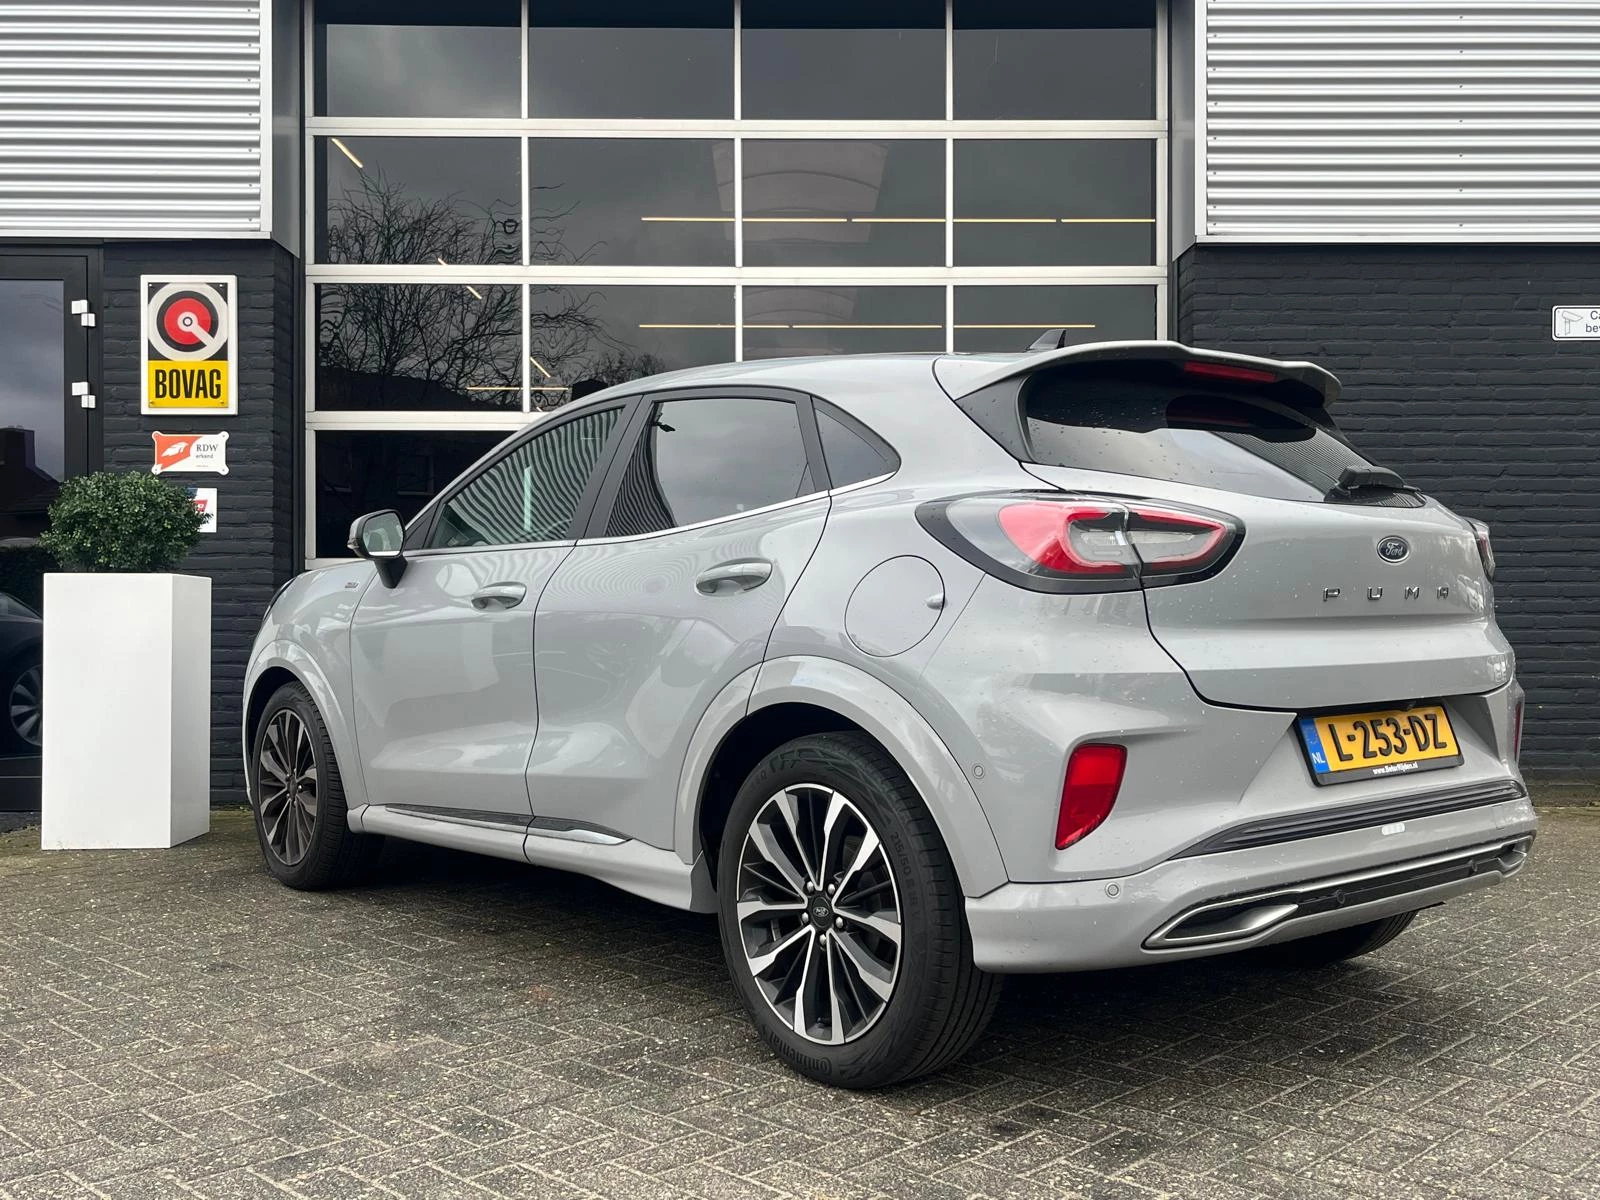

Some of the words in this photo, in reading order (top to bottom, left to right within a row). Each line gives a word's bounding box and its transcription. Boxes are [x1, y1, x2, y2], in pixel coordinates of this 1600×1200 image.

[155, 369, 222, 399] BOVAG
[196, 444, 218, 452] RDW
[1386, 542, 1403, 556] Ford
[1323, 586, 1449, 602] PUMA
[1328, 713, 1447, 762] L-253-DZ
[1311, 752, 1326, 764] NL
